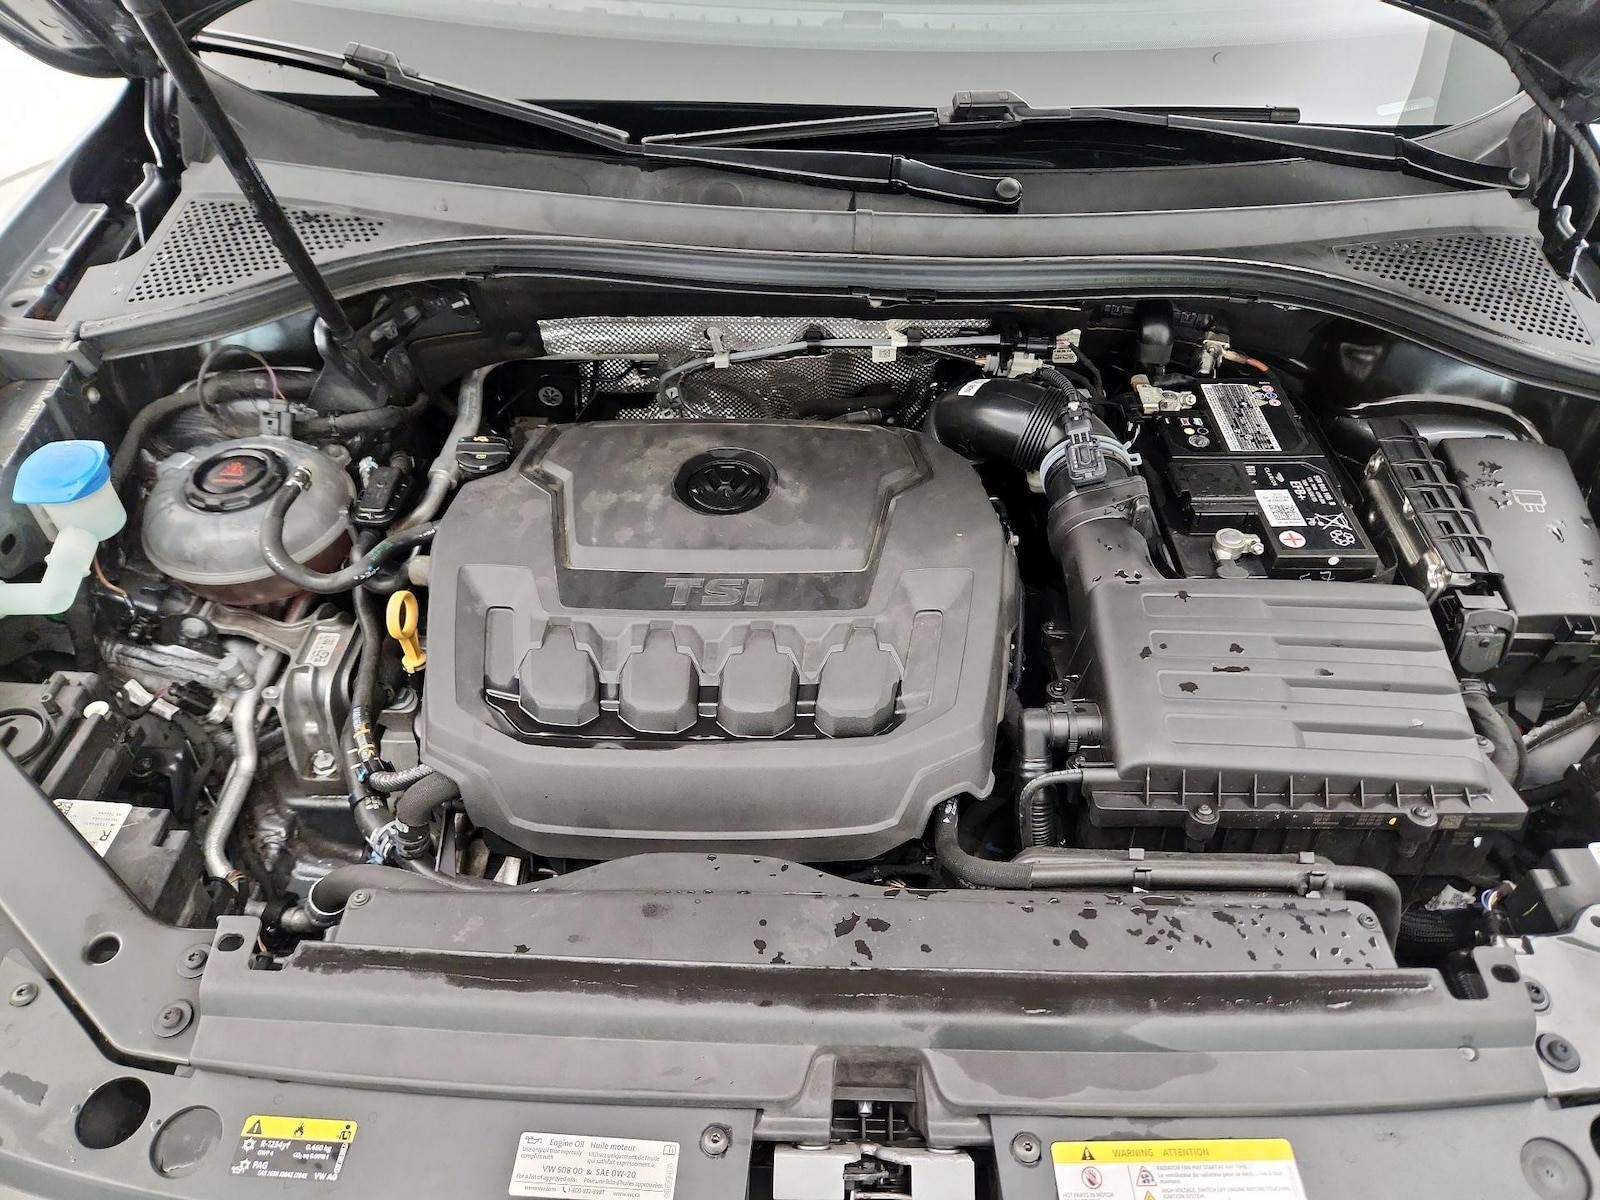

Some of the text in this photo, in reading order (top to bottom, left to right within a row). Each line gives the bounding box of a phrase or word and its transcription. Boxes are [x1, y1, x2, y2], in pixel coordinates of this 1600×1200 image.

[1290, 480, 1306, 500] EFB+
[664, 578, 764, 606] TSI
[260, 1140, 291, 1151] R-1234yf
[550, 1139, 573, 1148] Engine
[1112, 1148, 1210, 1157] WARNING ATTENTION
[252, 1161, 269, 1169] PAG
[328, 1173, 338, 1181] AG
[611, 1170, 636, 1178] 0W-20
